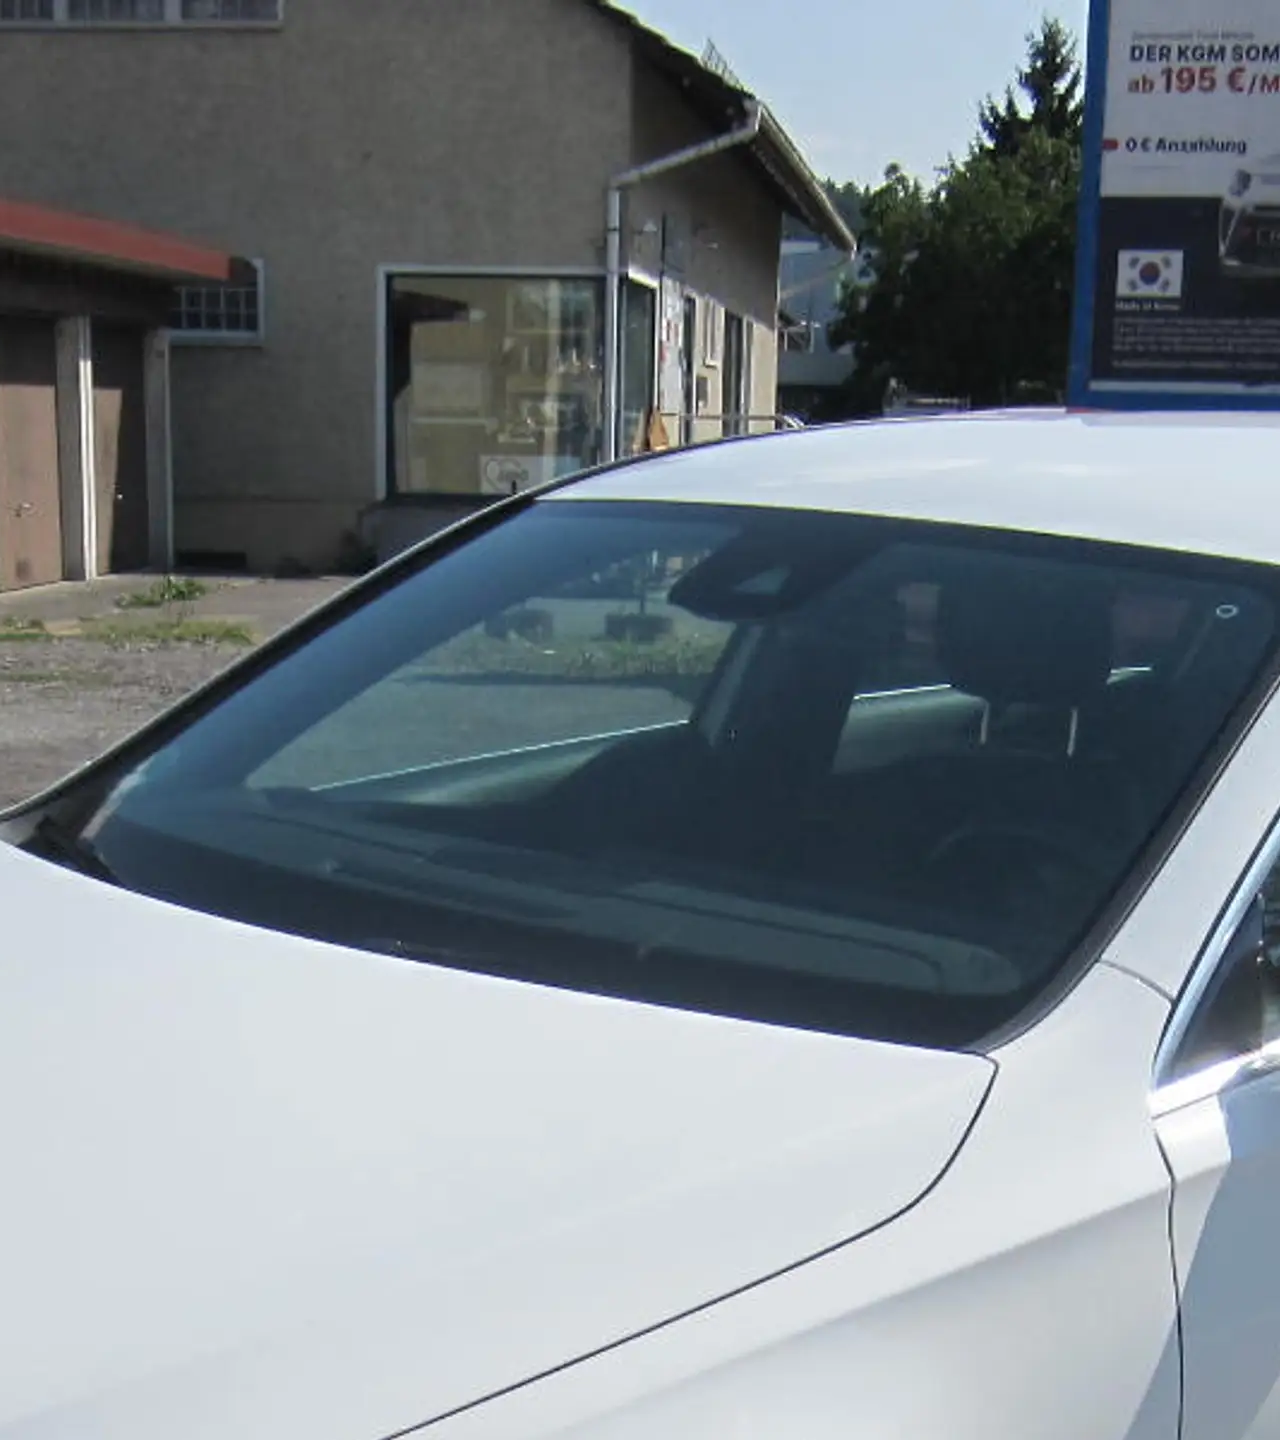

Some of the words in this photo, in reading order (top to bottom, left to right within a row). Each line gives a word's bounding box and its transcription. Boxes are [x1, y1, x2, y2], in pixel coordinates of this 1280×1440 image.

[1130, 44, 1171, 62] DER
[1177, 44, 1226, 62] KGM
[1128, 75, 1155, 94] ab
[1160, 66, 1218, 94] 195
[1125, 136, 1138, 153] 0
[1141, 136, 1152, 153] €
[1156, 136, 1247, 156] Anzahlung
